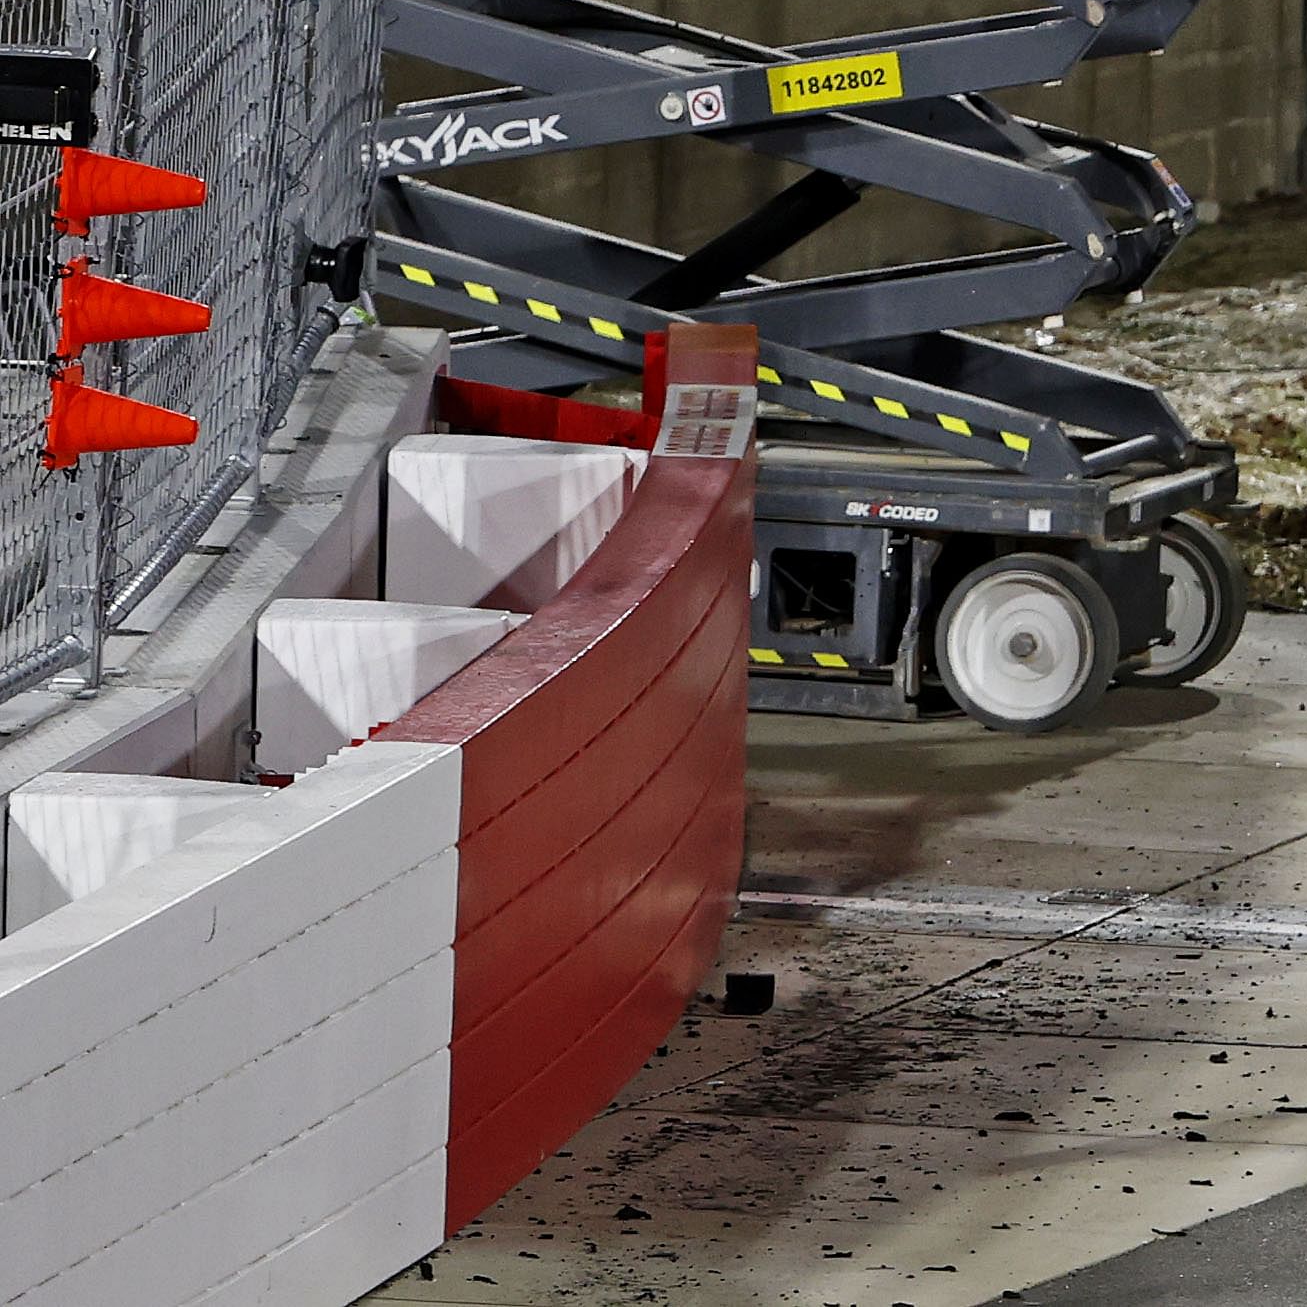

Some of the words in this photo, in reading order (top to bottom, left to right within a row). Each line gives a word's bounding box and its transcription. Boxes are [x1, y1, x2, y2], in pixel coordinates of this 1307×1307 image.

[781, 67, 887, 98] 11842802
[0, 121, 74, 142] HELEN
[361, 111, 568, 169] KYJACK
